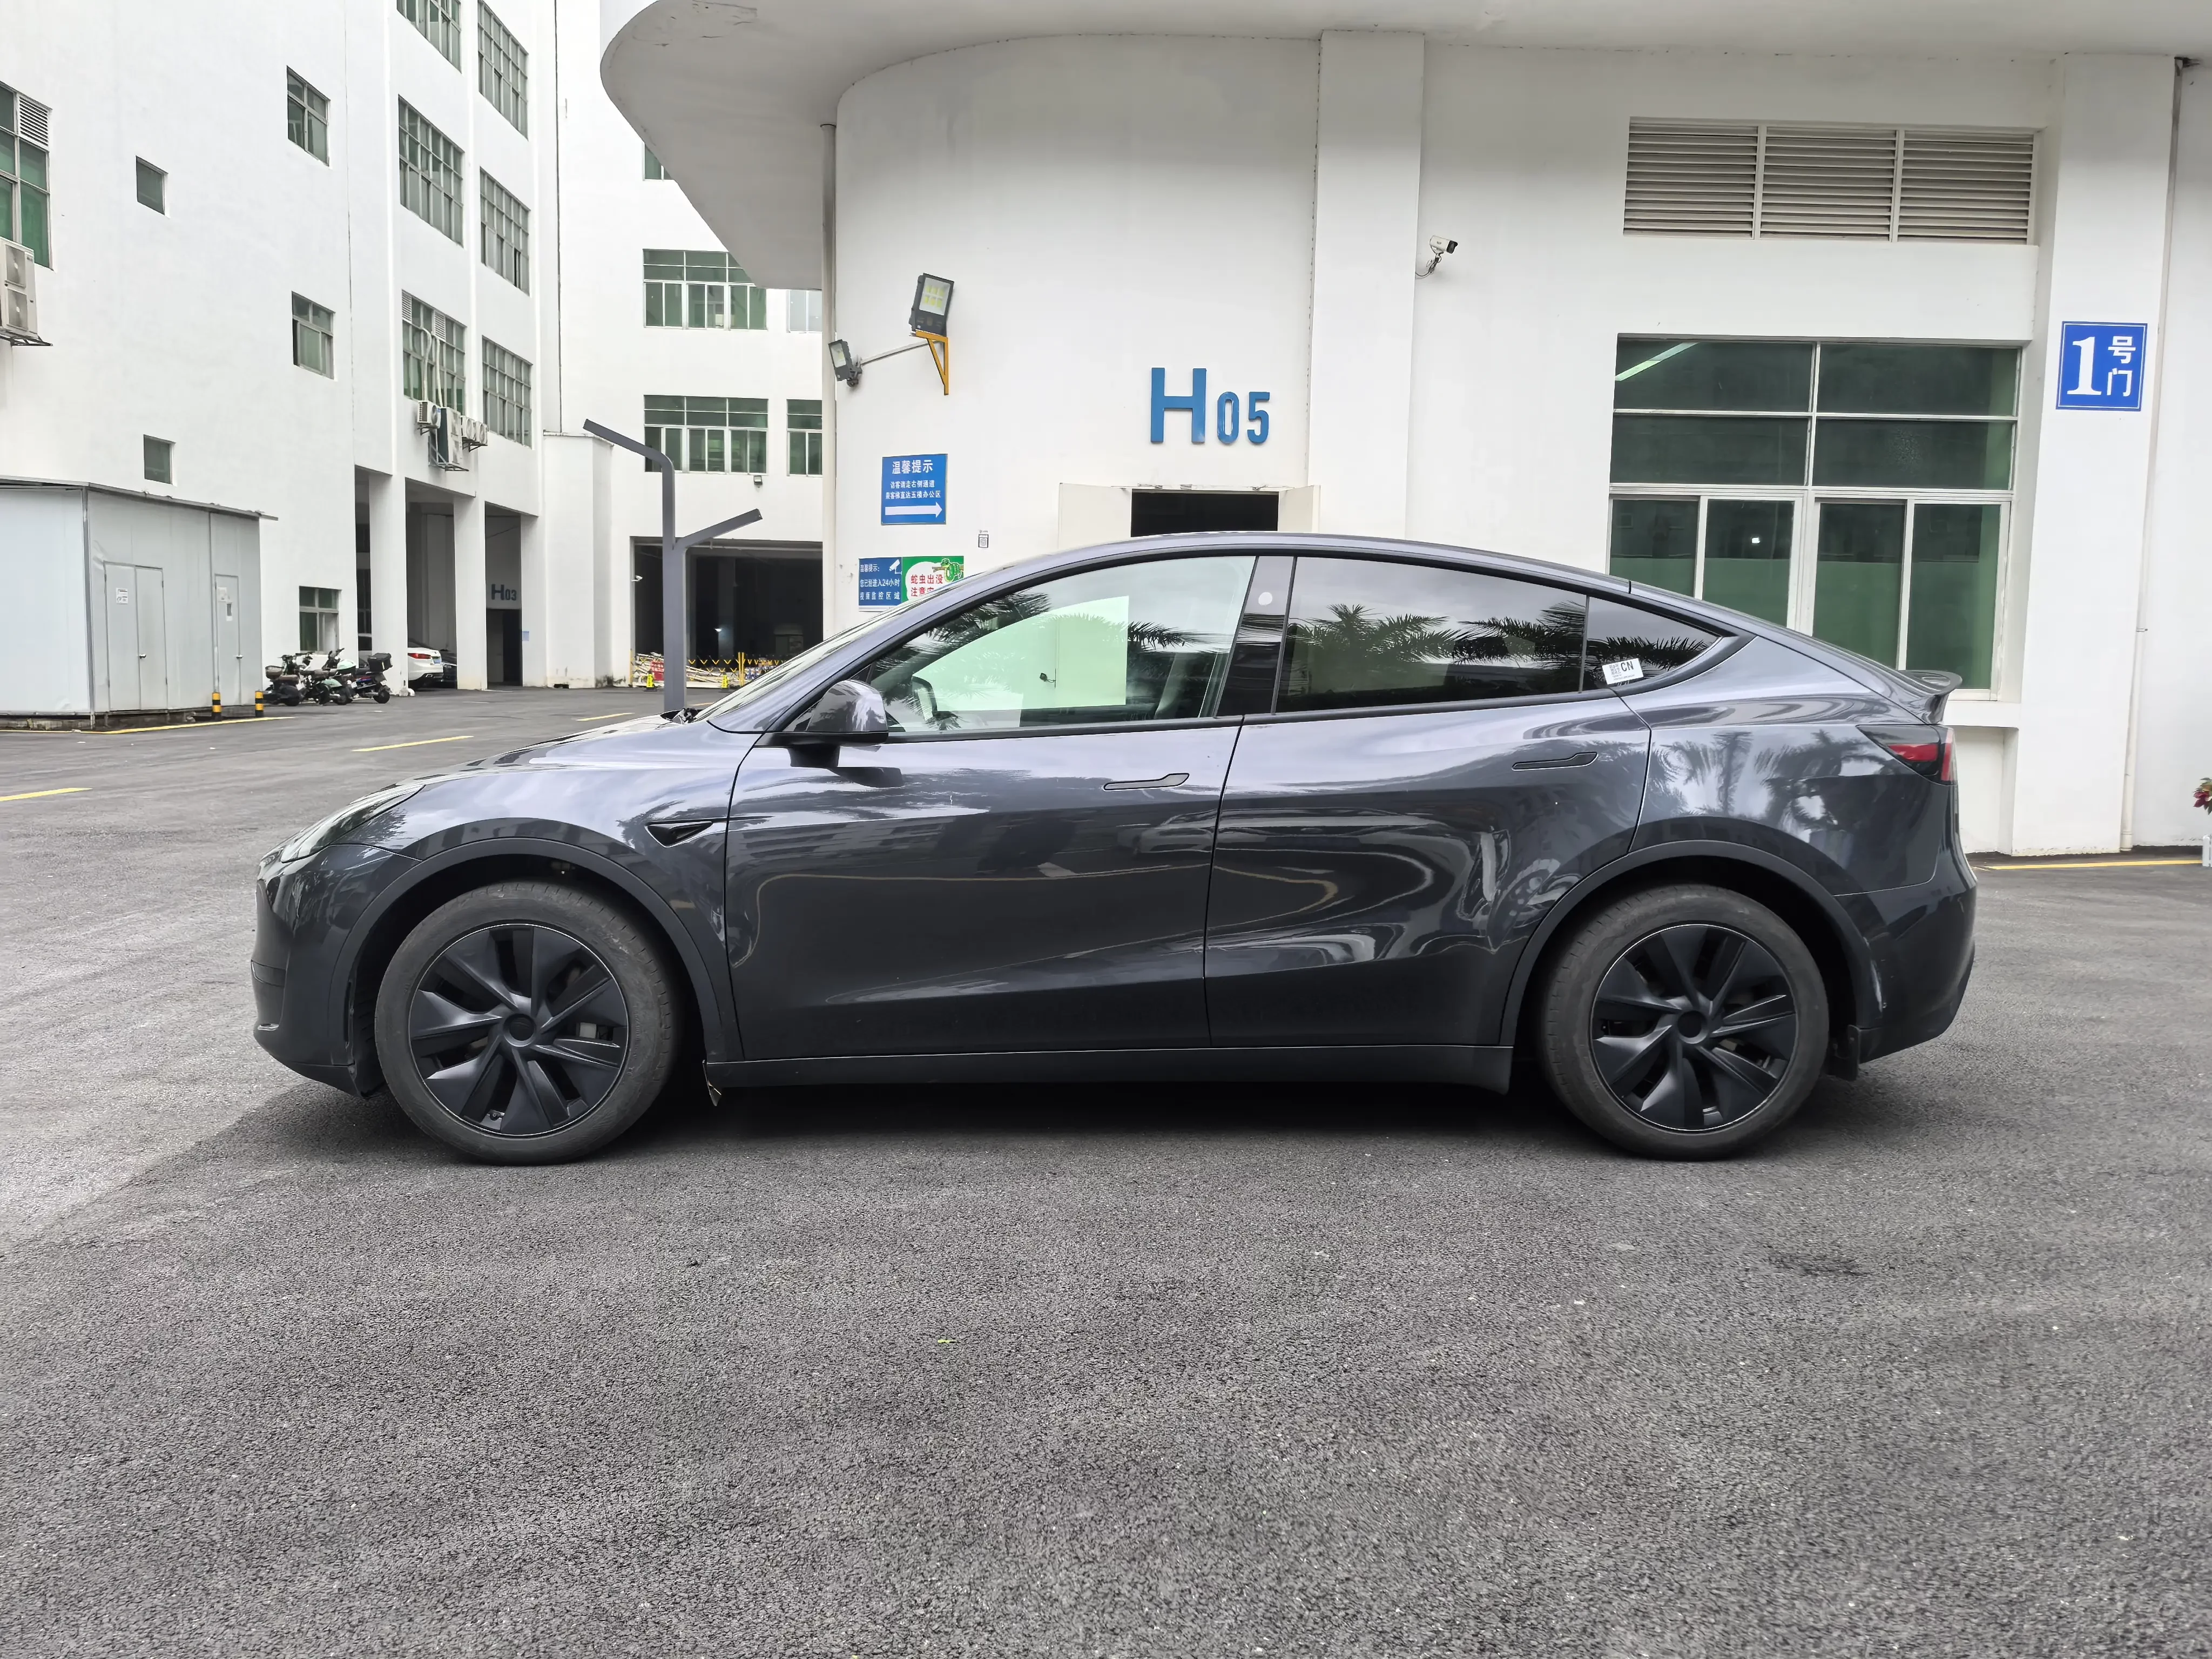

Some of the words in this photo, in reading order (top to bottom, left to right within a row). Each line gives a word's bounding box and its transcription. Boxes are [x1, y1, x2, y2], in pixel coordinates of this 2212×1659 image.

[1150, 367, 1270, 444] H05
[892, 460, 933, 474] 温馨提示
[891, 480, 935, 489] 访客请走右侧通道
[911, 574, 943, 584] 蛇虫出没
[491, 583, 517, 601] H03
[1621, 660, 1634, 672] CN
